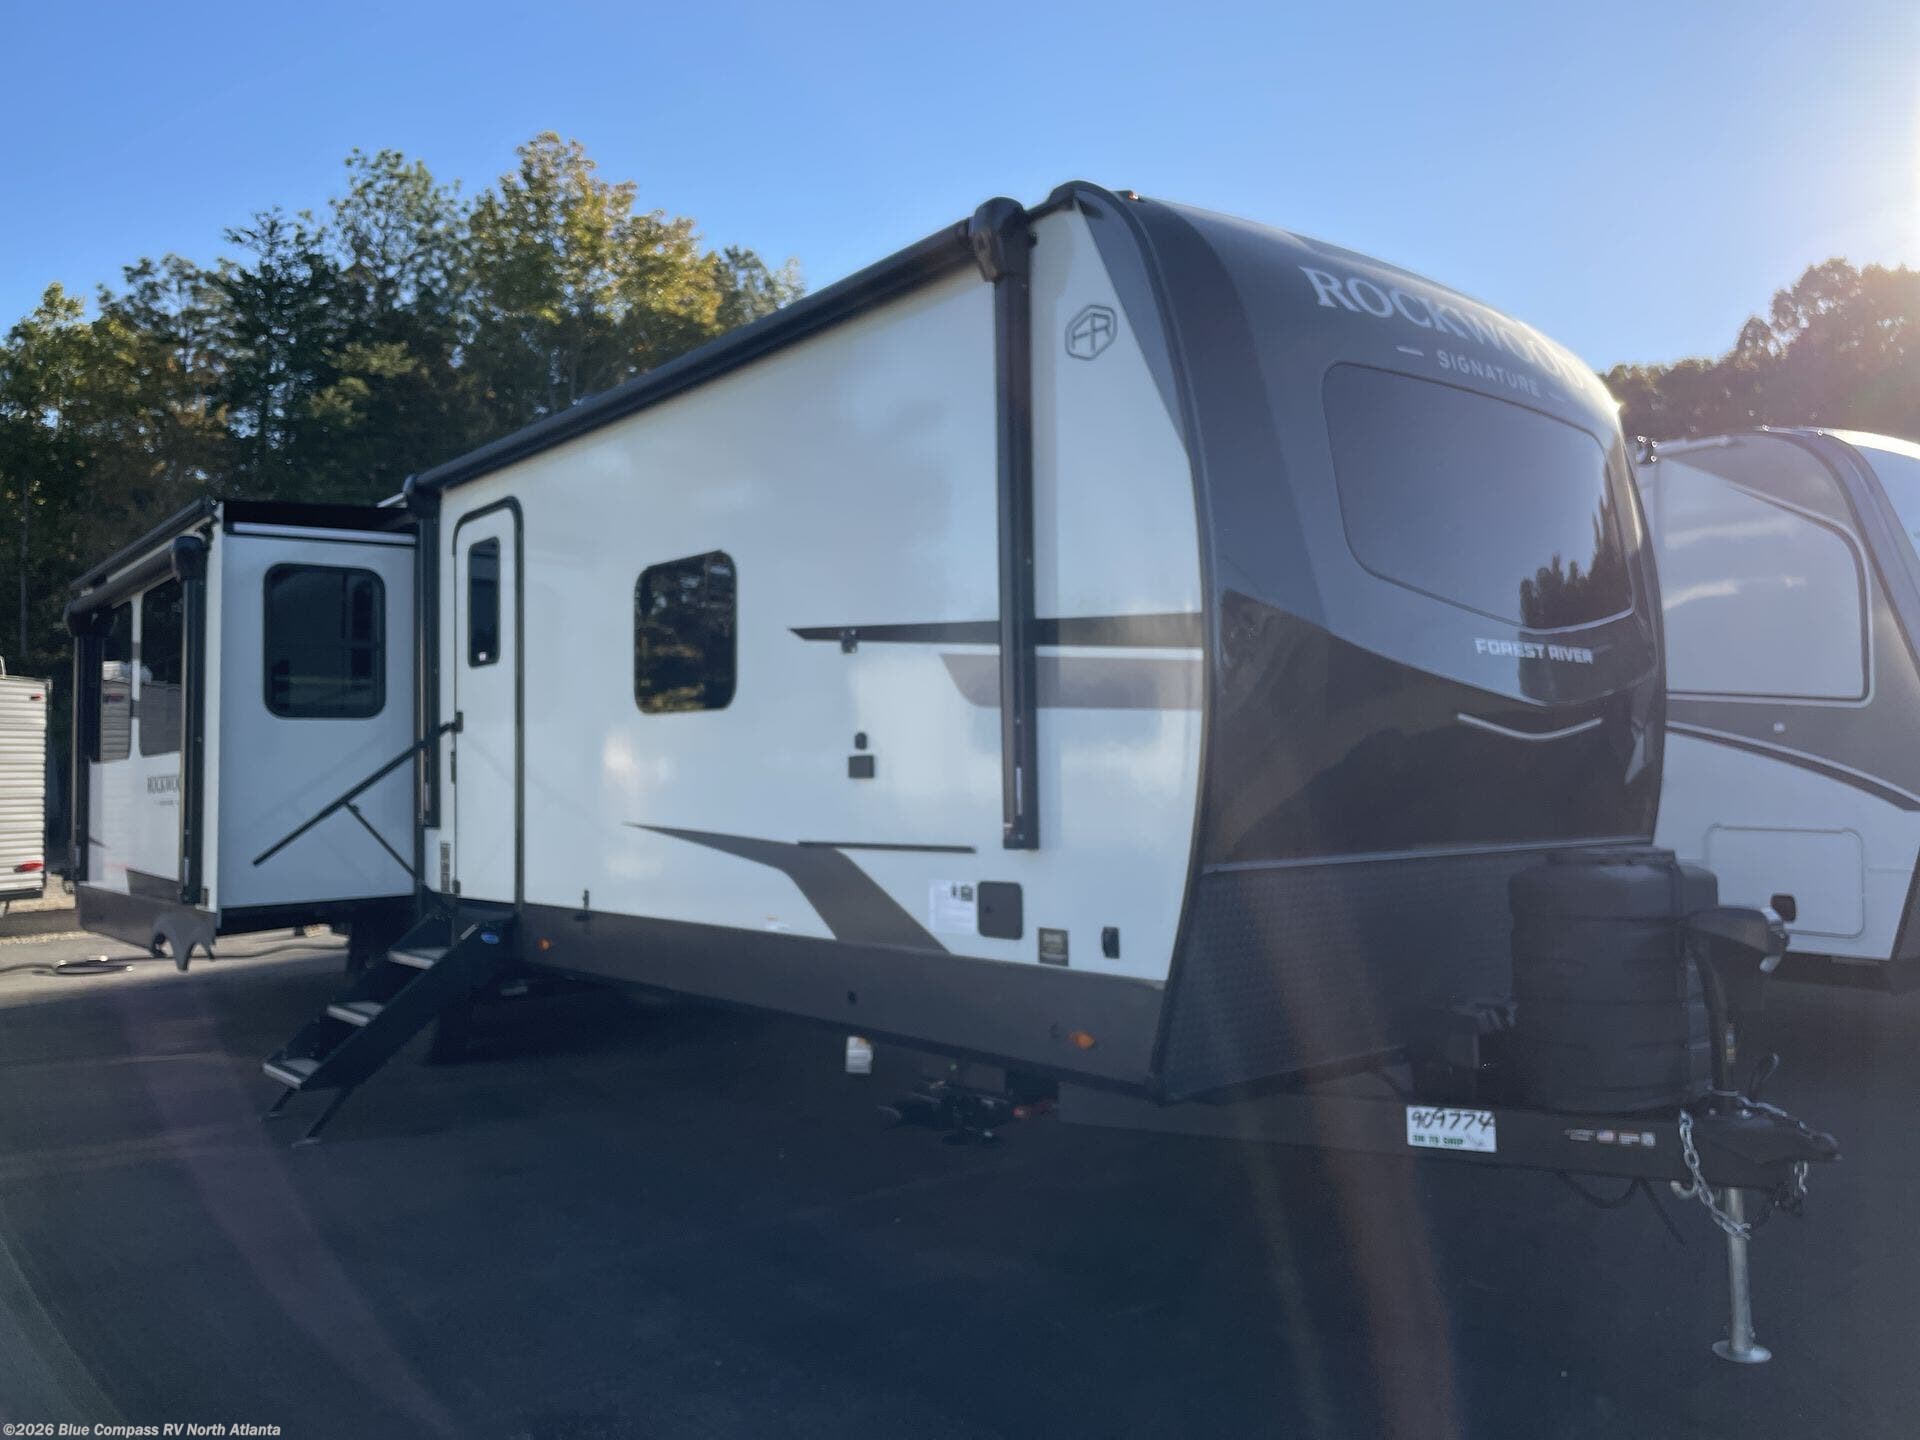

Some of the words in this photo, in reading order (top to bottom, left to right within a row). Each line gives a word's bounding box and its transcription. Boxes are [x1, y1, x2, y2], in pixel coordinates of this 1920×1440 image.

[1436, 350, 1541, 398] SIGNATURE
[1474, 637, 1544, 659] FOREST
[1548, 643, 1593, 665] RIVER
